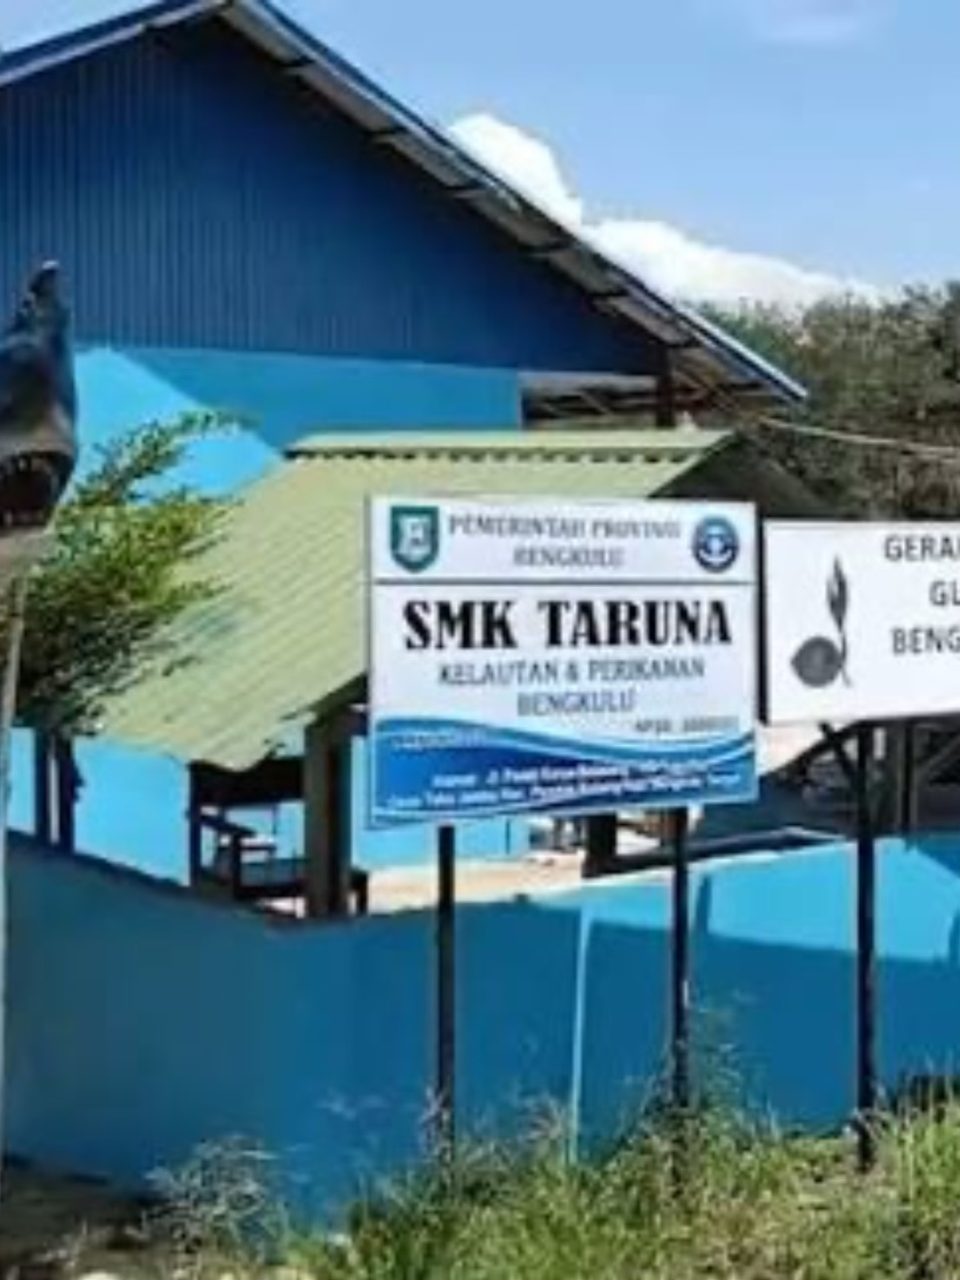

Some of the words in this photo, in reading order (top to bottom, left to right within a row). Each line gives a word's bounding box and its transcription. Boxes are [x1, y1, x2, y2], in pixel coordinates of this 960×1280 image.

[403, 599, 518, 650] SMK
[537, 599, 732, 646] TARUNA
[439, 661, 560, 685] KELAUTAN
[588, 656, 705, 682] PERIKANAN
[517, 689, 636, 716] BENGKULU
